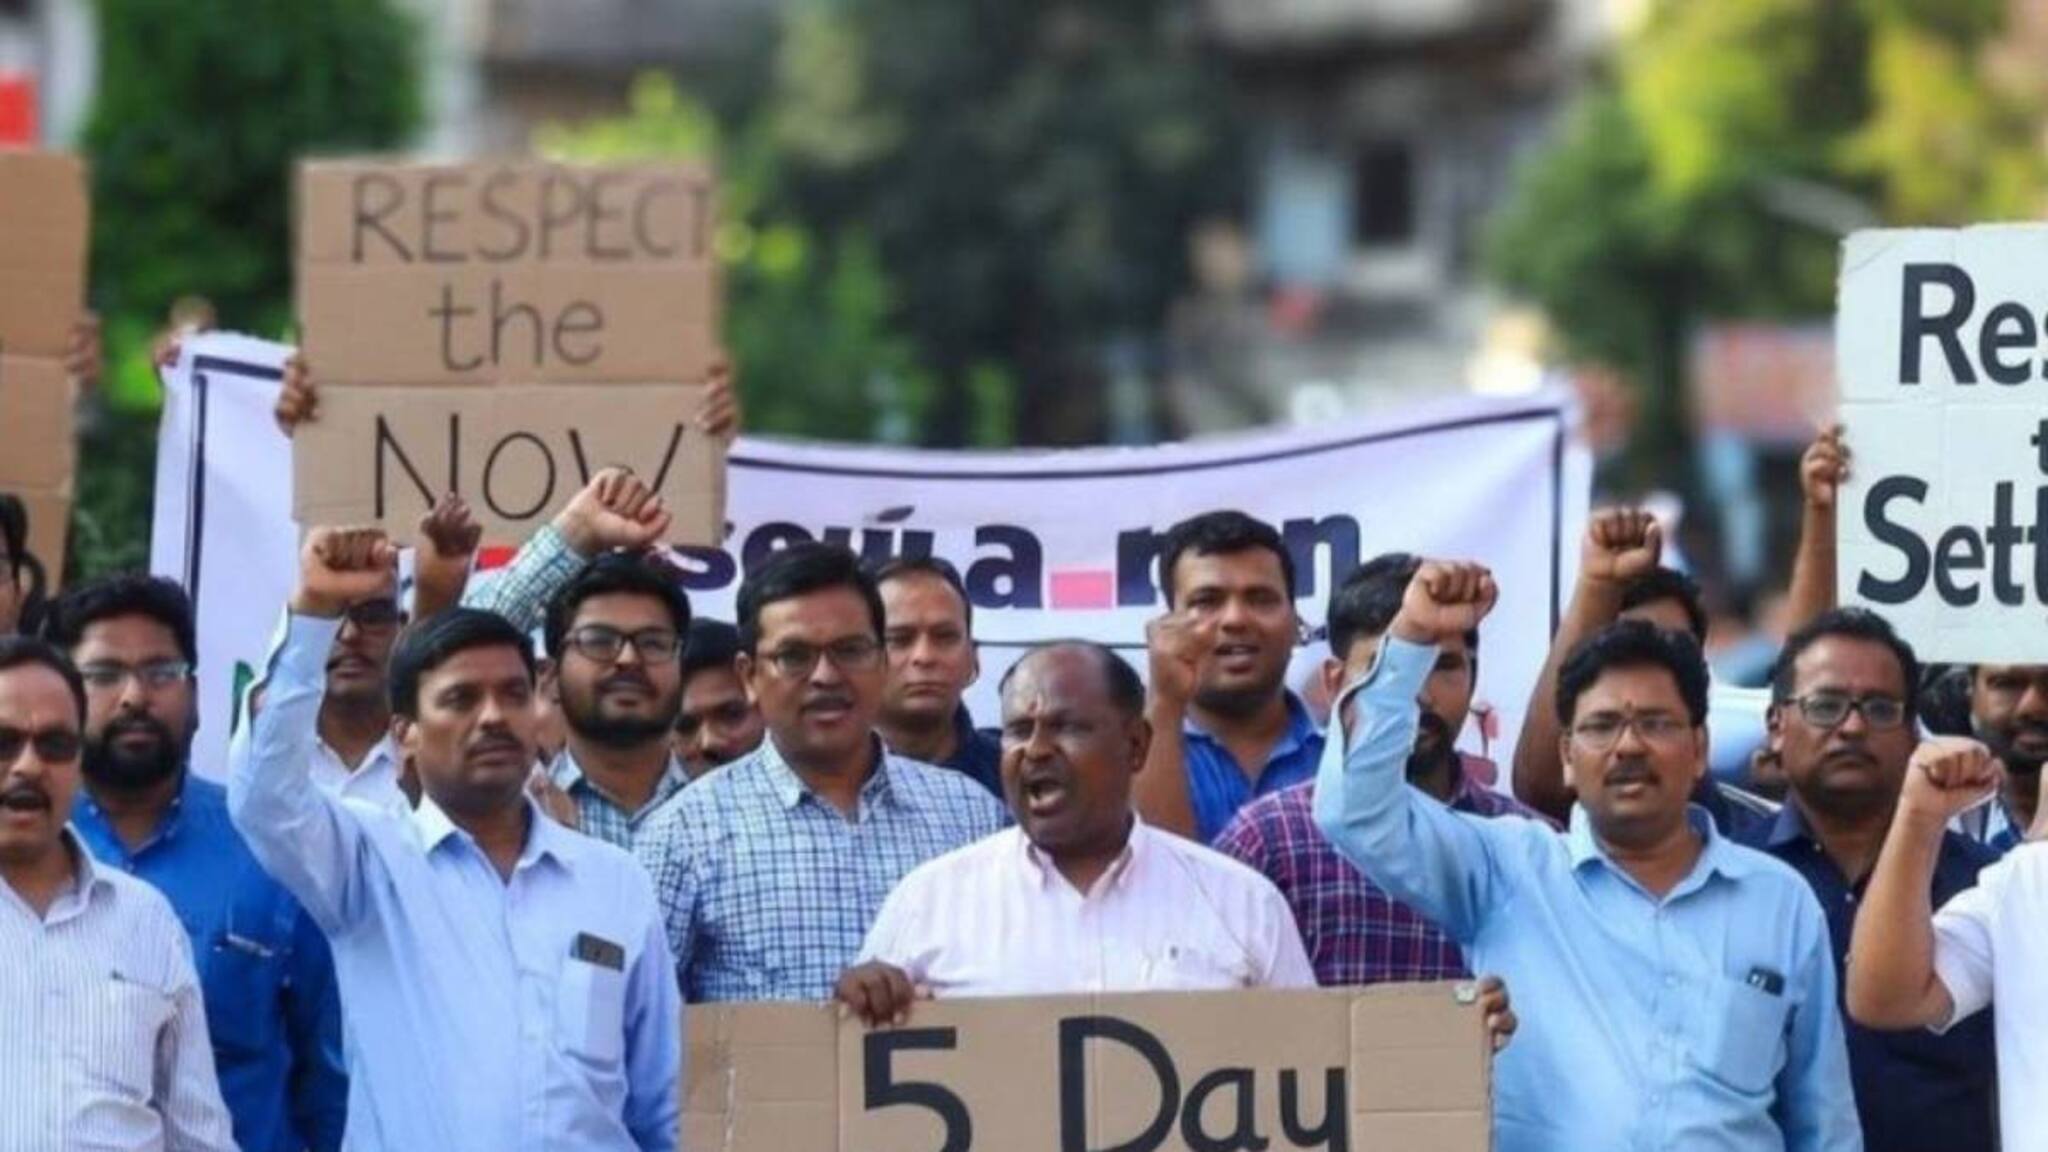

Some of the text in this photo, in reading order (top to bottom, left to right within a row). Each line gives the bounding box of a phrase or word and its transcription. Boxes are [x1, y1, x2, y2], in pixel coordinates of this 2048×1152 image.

[429, 280, 604, 372] the
[1899, 262, 2048, 386] Re
[864, 1026, 972, 1152] 5
